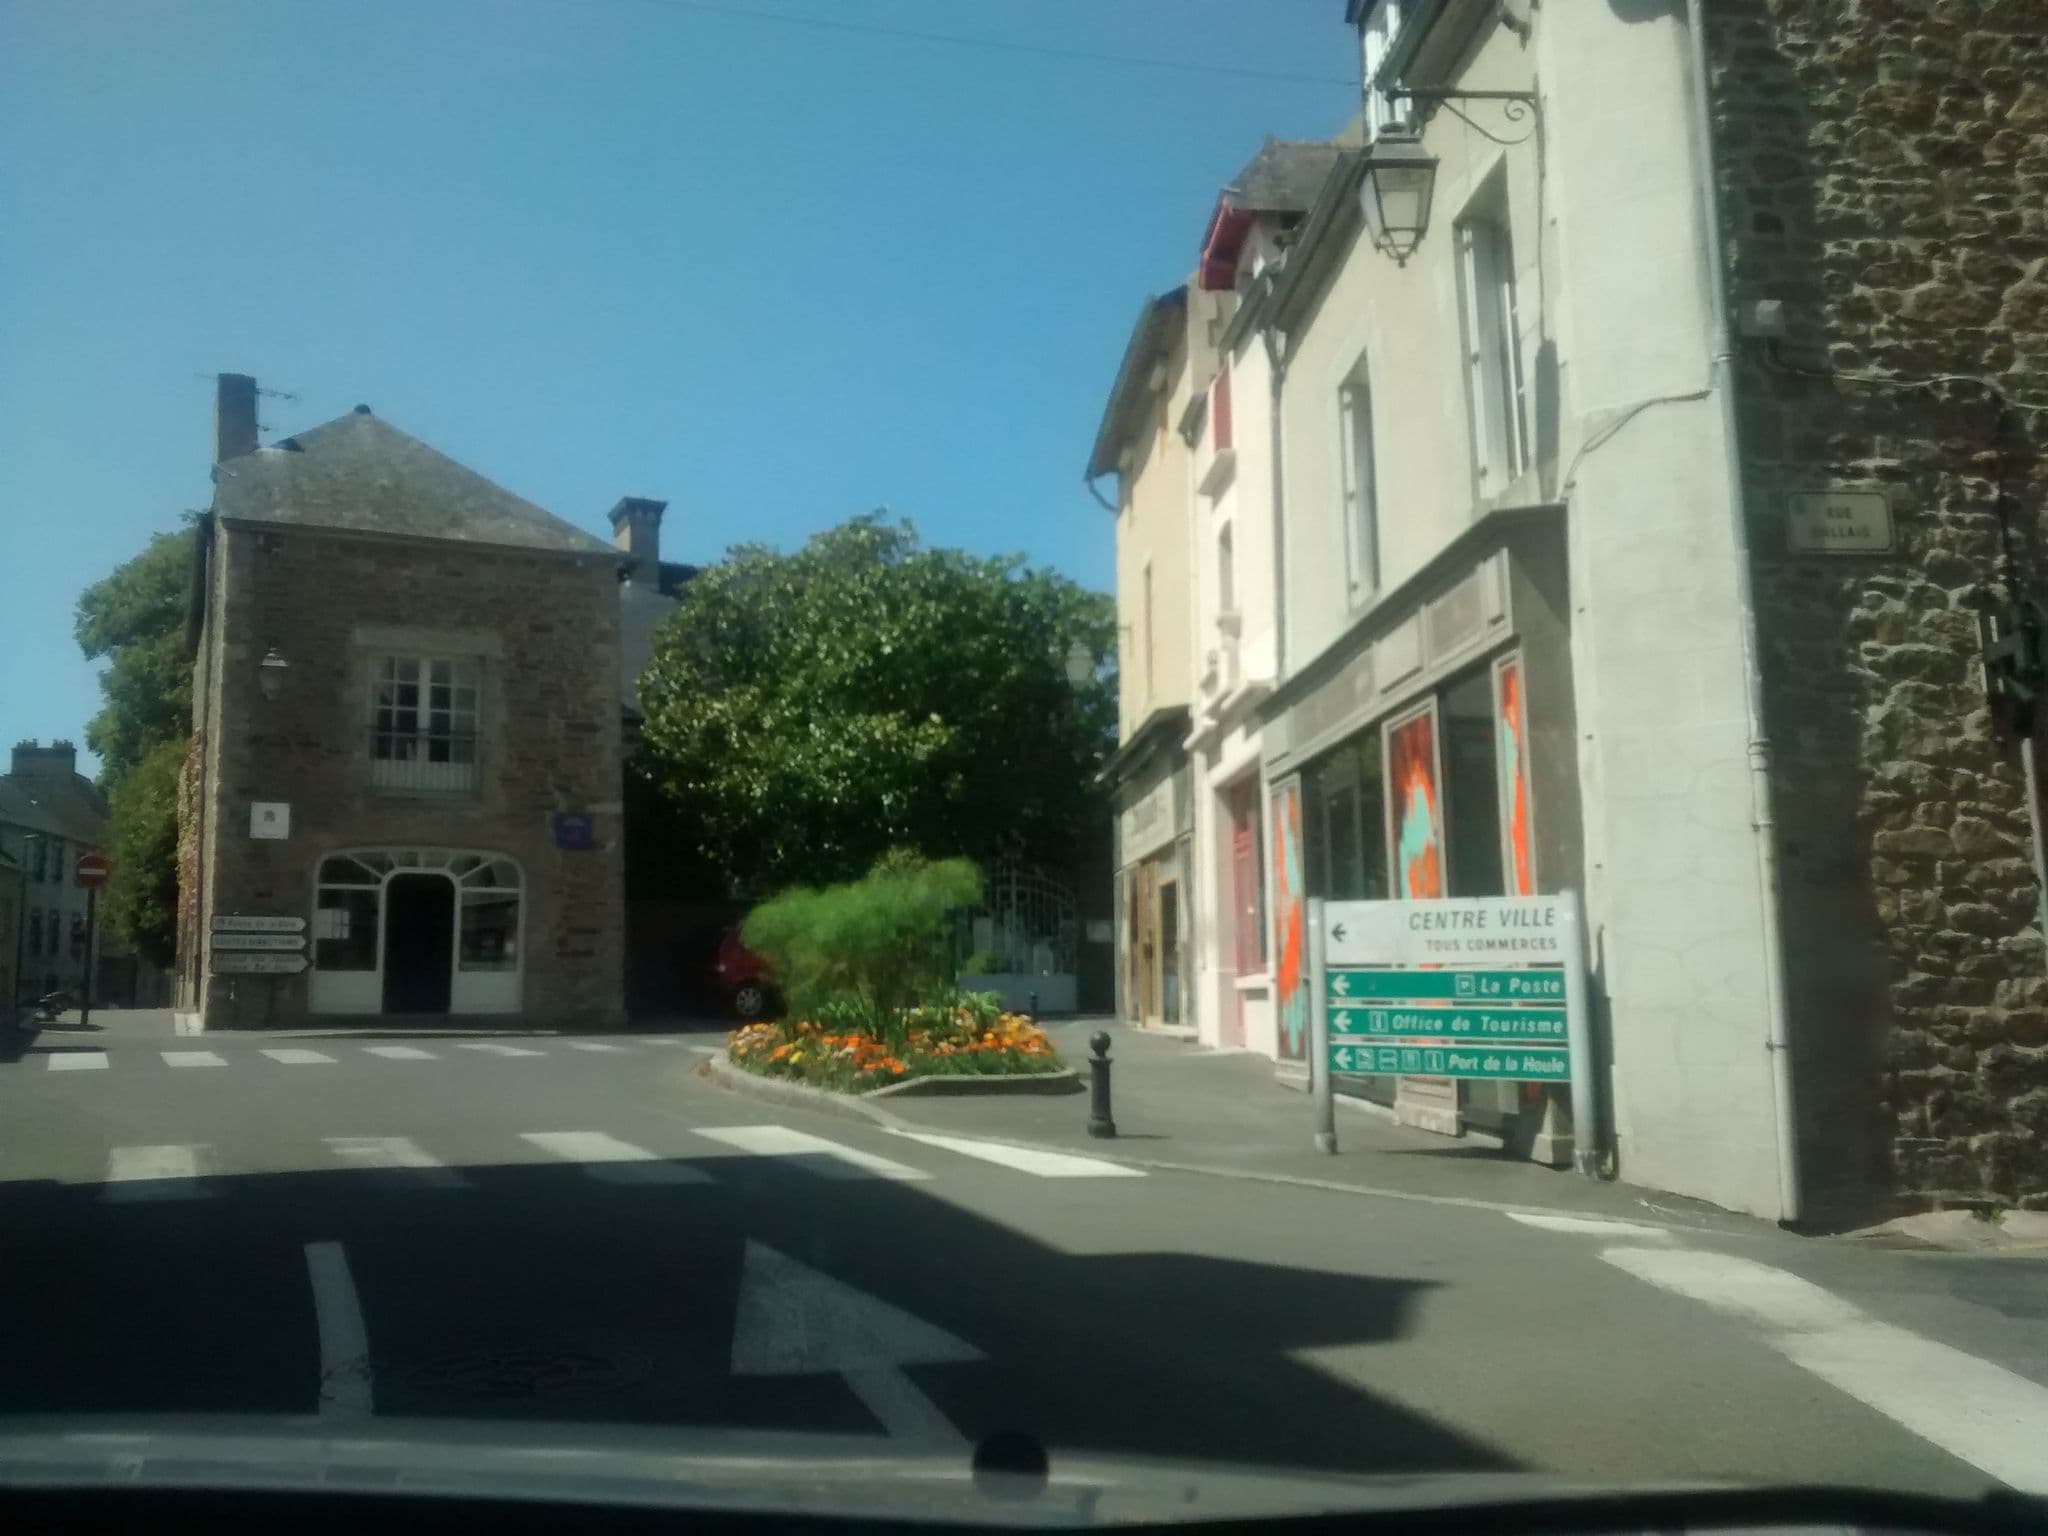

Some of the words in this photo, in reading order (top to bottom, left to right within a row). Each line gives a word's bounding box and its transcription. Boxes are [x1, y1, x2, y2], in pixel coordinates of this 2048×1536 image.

[1826, 506, 1853, 519] RUE
[1409, 909, 1488, 931] CENTRE
[1499, 907, 1556, 928] VILLE
[1425, 938, 1460, 952] TOUS
[1466, 937, 1558, 951] COMMERCES
[1480, 977, 1501, 993] La
[1508, 977, 1561, 994] Poste
[1392, 1014, 1444, 1031] Office
[1451, 1015, 1471, 1032] de
[1481, 1015, 1564, 1034] Tourisme
[1449, 1054, 1478, 1071] Port
[1483, 1055, 1500, 1071] de
[1504, 1055, 1519, 1072] la
